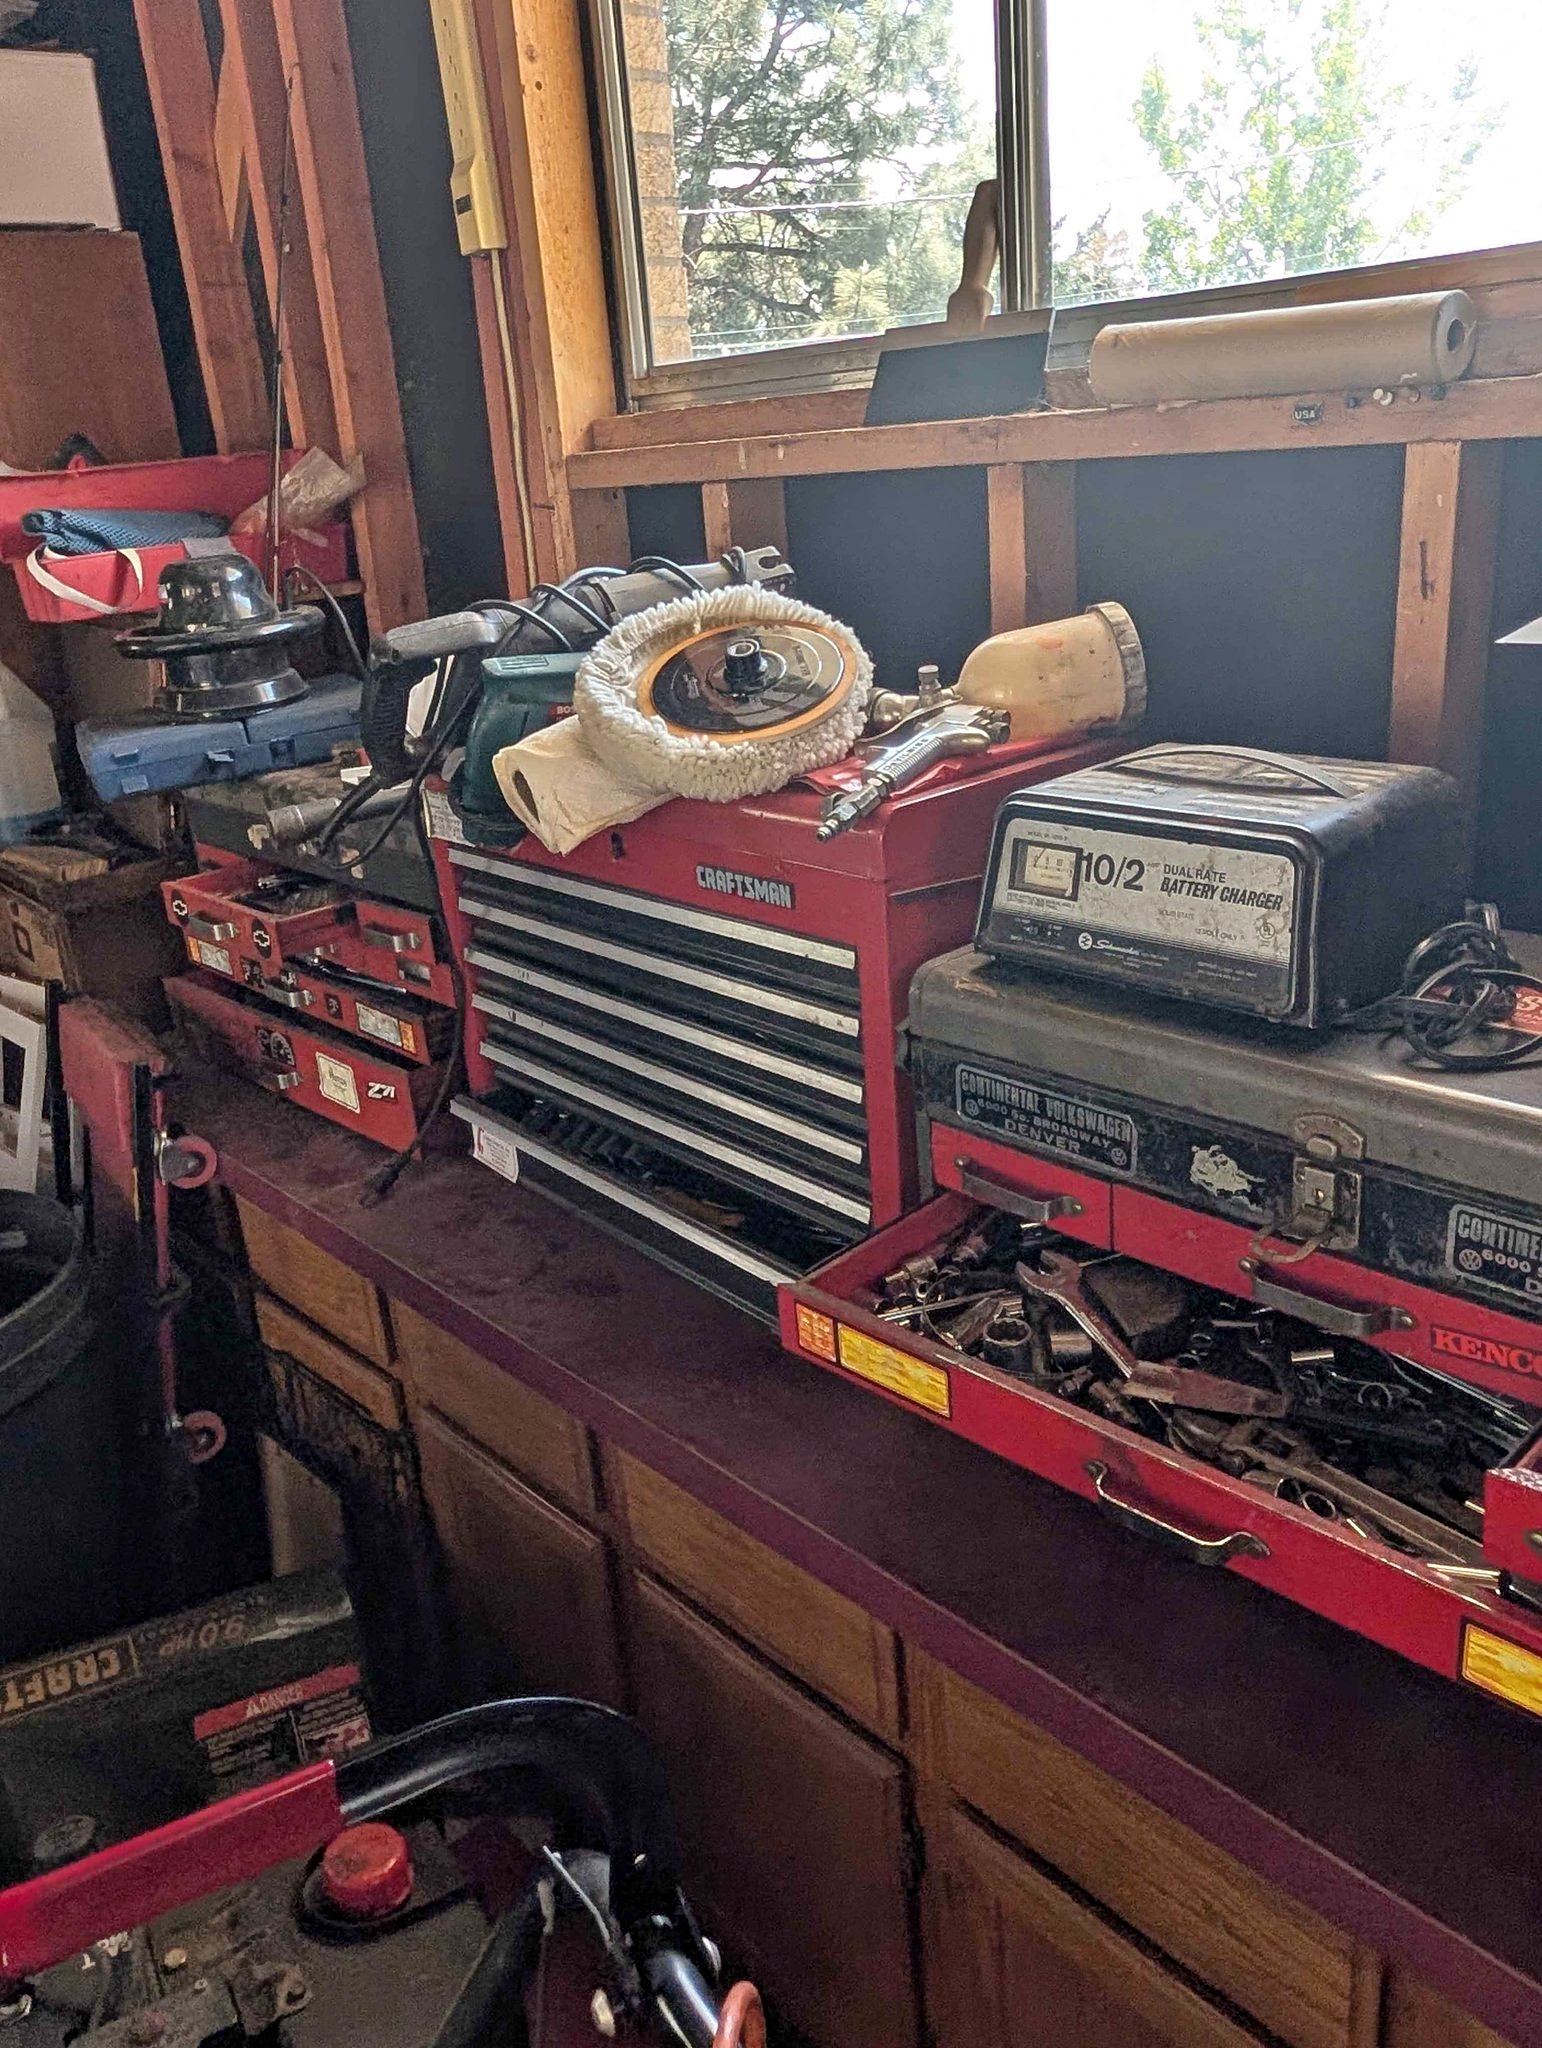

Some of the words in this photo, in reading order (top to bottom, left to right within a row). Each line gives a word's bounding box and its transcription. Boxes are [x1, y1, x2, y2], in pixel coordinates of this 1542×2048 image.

[1294, 409, 1315, 420] USA
[557, 705, 575, 715] BO
[695, 865, 792, 909] CRAFTSMAN
[1082, 852, 1145, 892] 10/2
[1163, 864, 1193, 879] DUAL
[1195, 868, 1227, 884] RATE
[1160, 877, 1220, 900] BATTERY
[1219, 886, 1284, 911] CHARGER
[960, 1070, 1041, 1114] CONTINENTAL
[1045, 1096, 1132, 1142] VOLKSWAGEN
[1004, 1118, 1081, 1154] DENVER
[1033, 1117, 1111, 1149] BROADWAY
[1458, 1213, 1542, 1262] CONTINE
[0, 1648, 122, 1712] CRAFT
